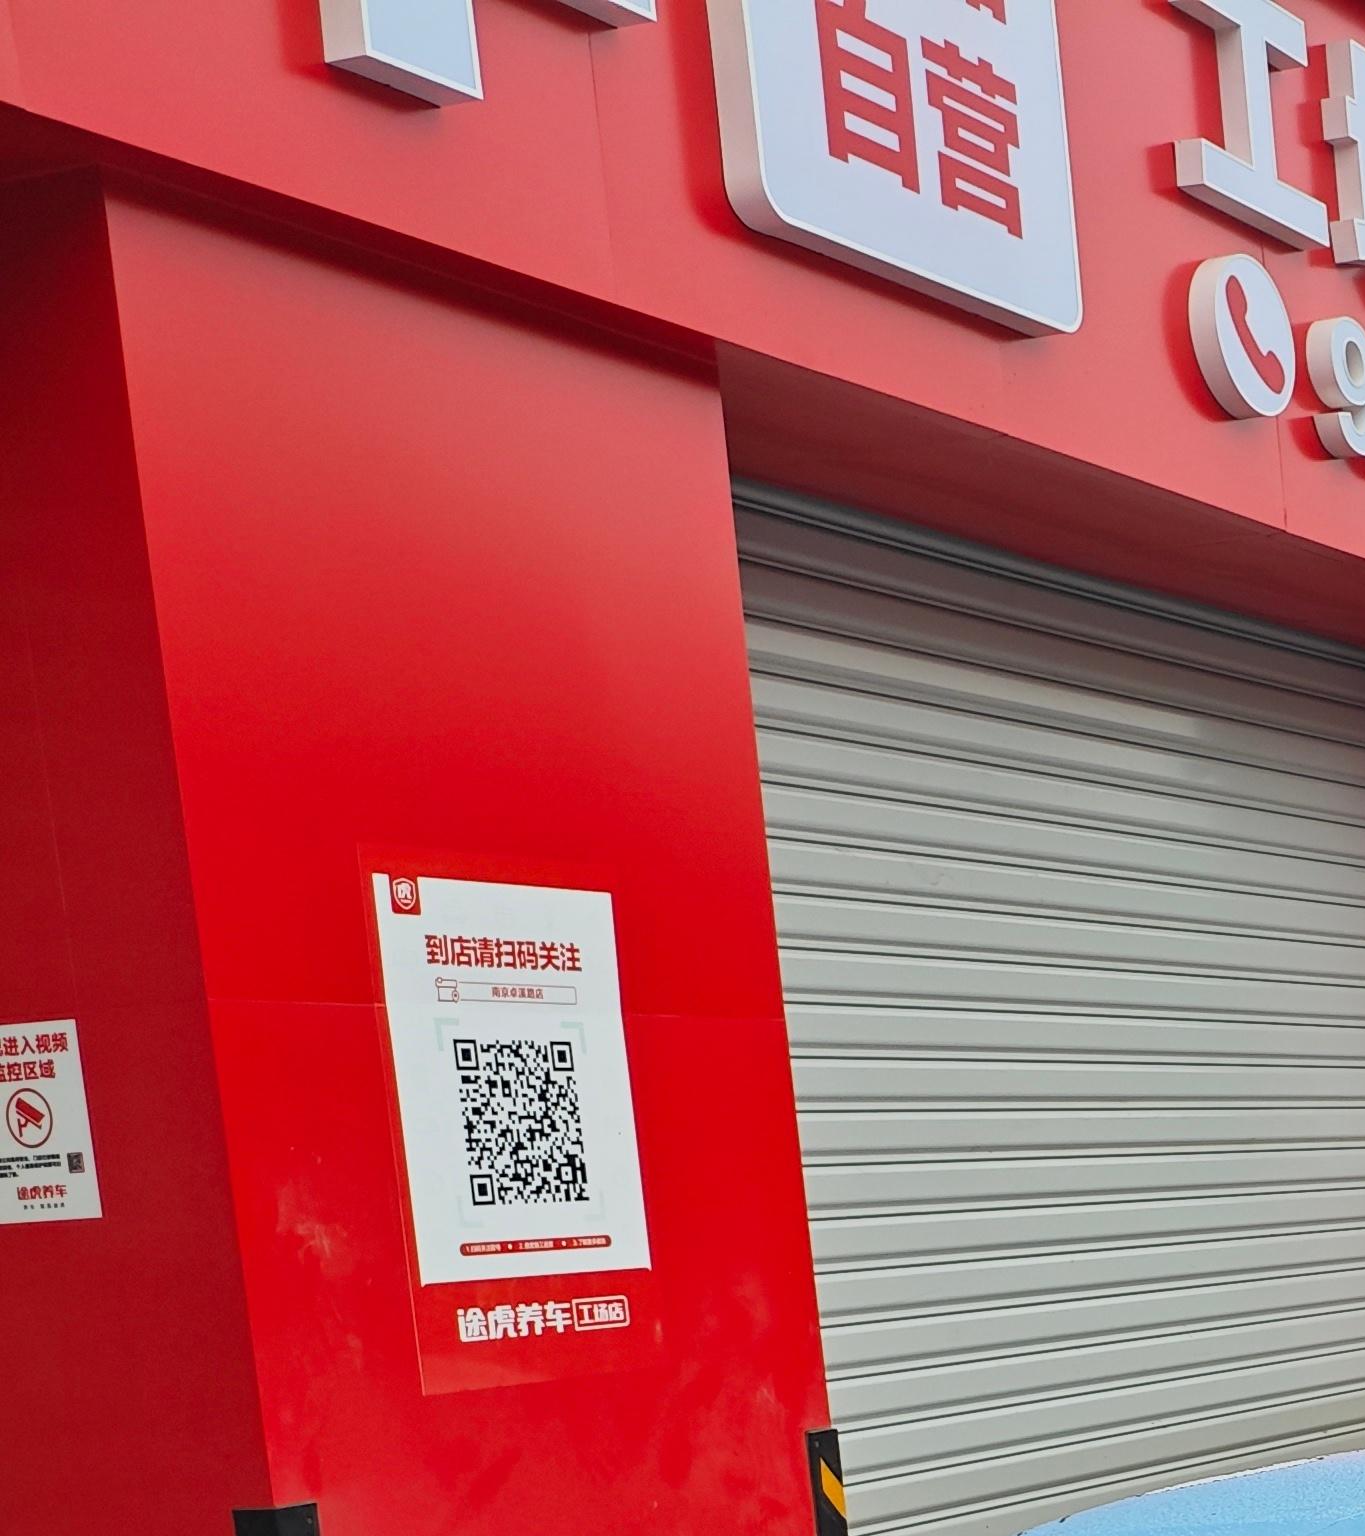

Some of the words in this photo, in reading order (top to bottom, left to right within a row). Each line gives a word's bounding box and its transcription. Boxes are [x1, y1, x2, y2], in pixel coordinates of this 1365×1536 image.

[424, 934, 583, 973] 到店请扫码关注
[457, 1300, 573, 1343] 途虎养车
[578, 1302, 625, 1326] 工场店
